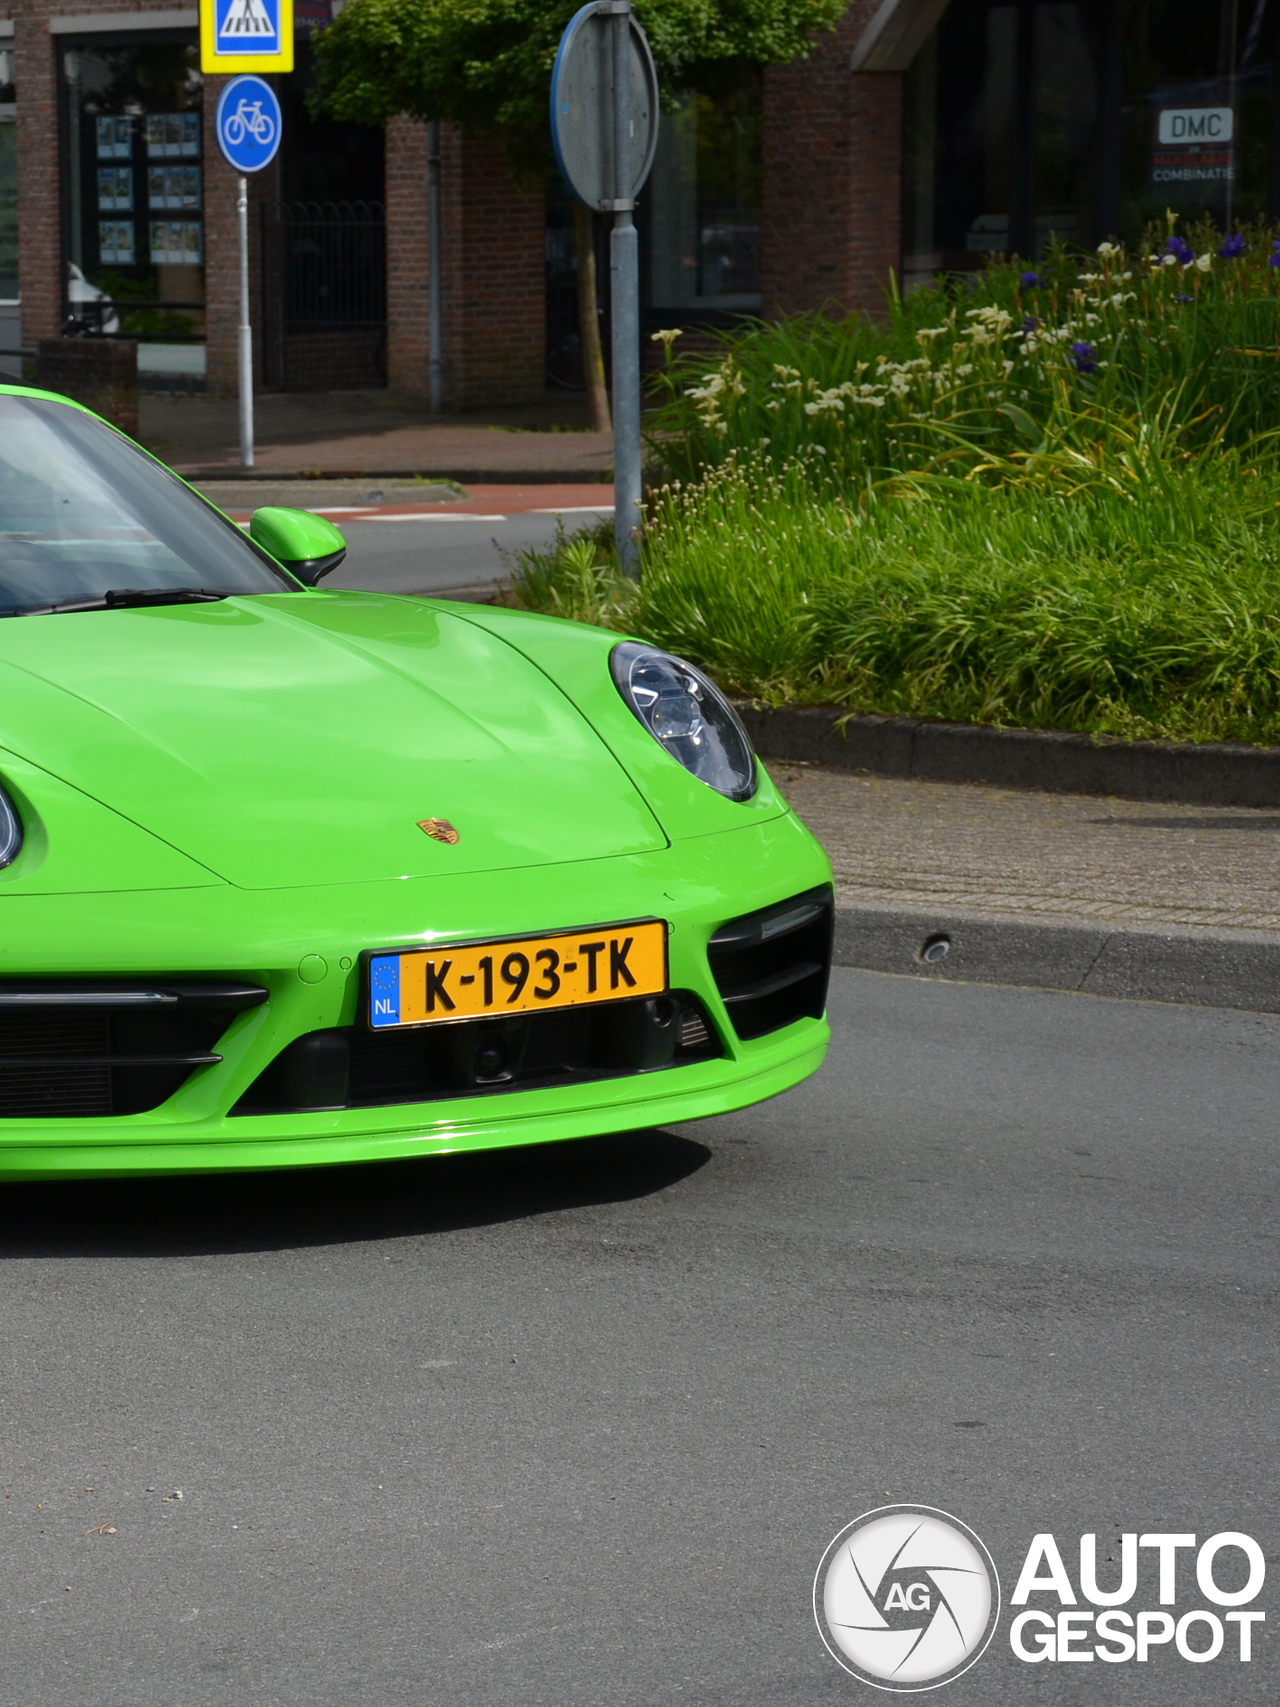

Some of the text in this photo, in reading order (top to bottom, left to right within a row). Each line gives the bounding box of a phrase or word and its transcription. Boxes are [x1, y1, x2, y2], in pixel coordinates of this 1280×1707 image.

[1172, 114, 1221, 137] DMC
[1153, 167, 1235, 181] COMBINATIE
[425, 937, 637, 1013] K-193-TK
[374, 998, 396, 1016] NL
